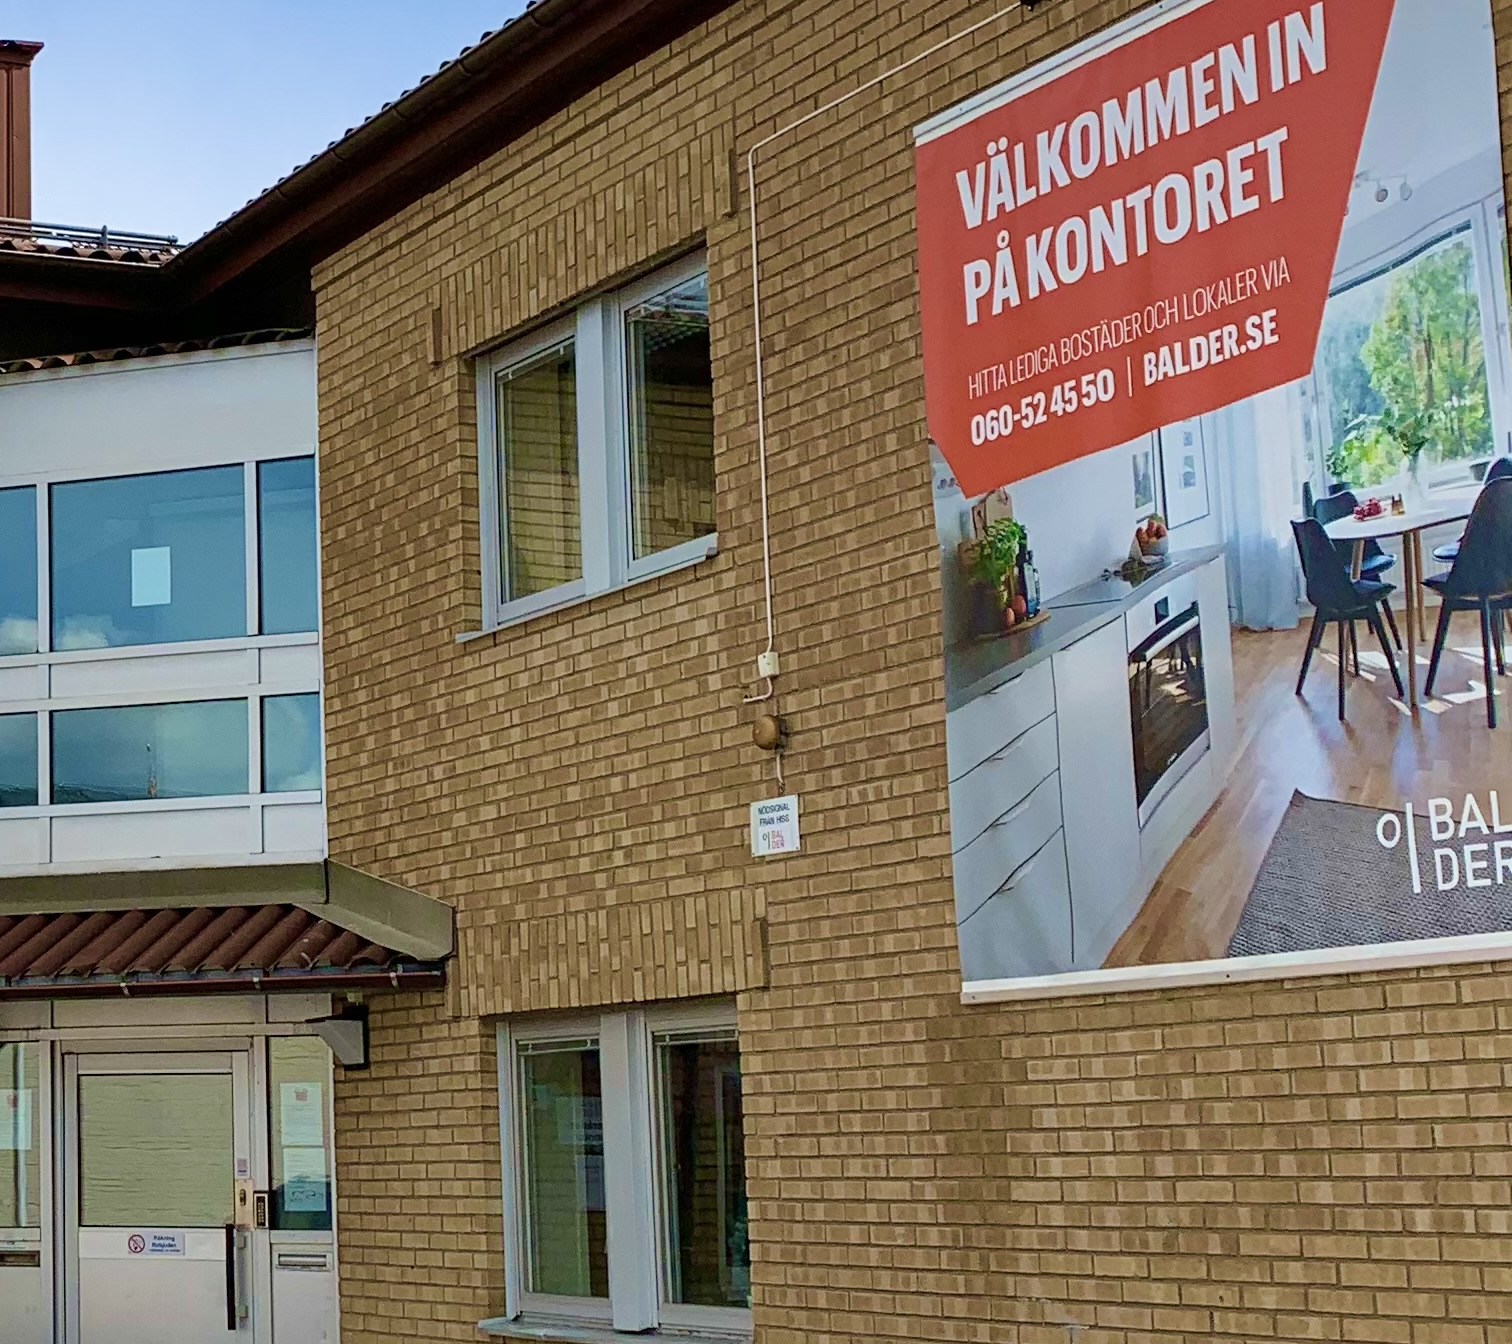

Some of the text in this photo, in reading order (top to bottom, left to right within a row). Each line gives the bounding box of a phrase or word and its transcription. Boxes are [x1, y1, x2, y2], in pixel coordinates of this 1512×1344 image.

[955, 1, 1328, 230] VÄLKOMMEN IN
[962, 125, 1289, 326] PÅ KONTORET
[968, 256, 1291, 400] HITTA LEDIGA BOSTÄDER OCH LOKALER VIA
[970, 309, 1279, 446] 060-52 45 50 BALDER.SE
[1428, 790, 1512, 842] BAL
[1434, 840, 1512, 891] DER
